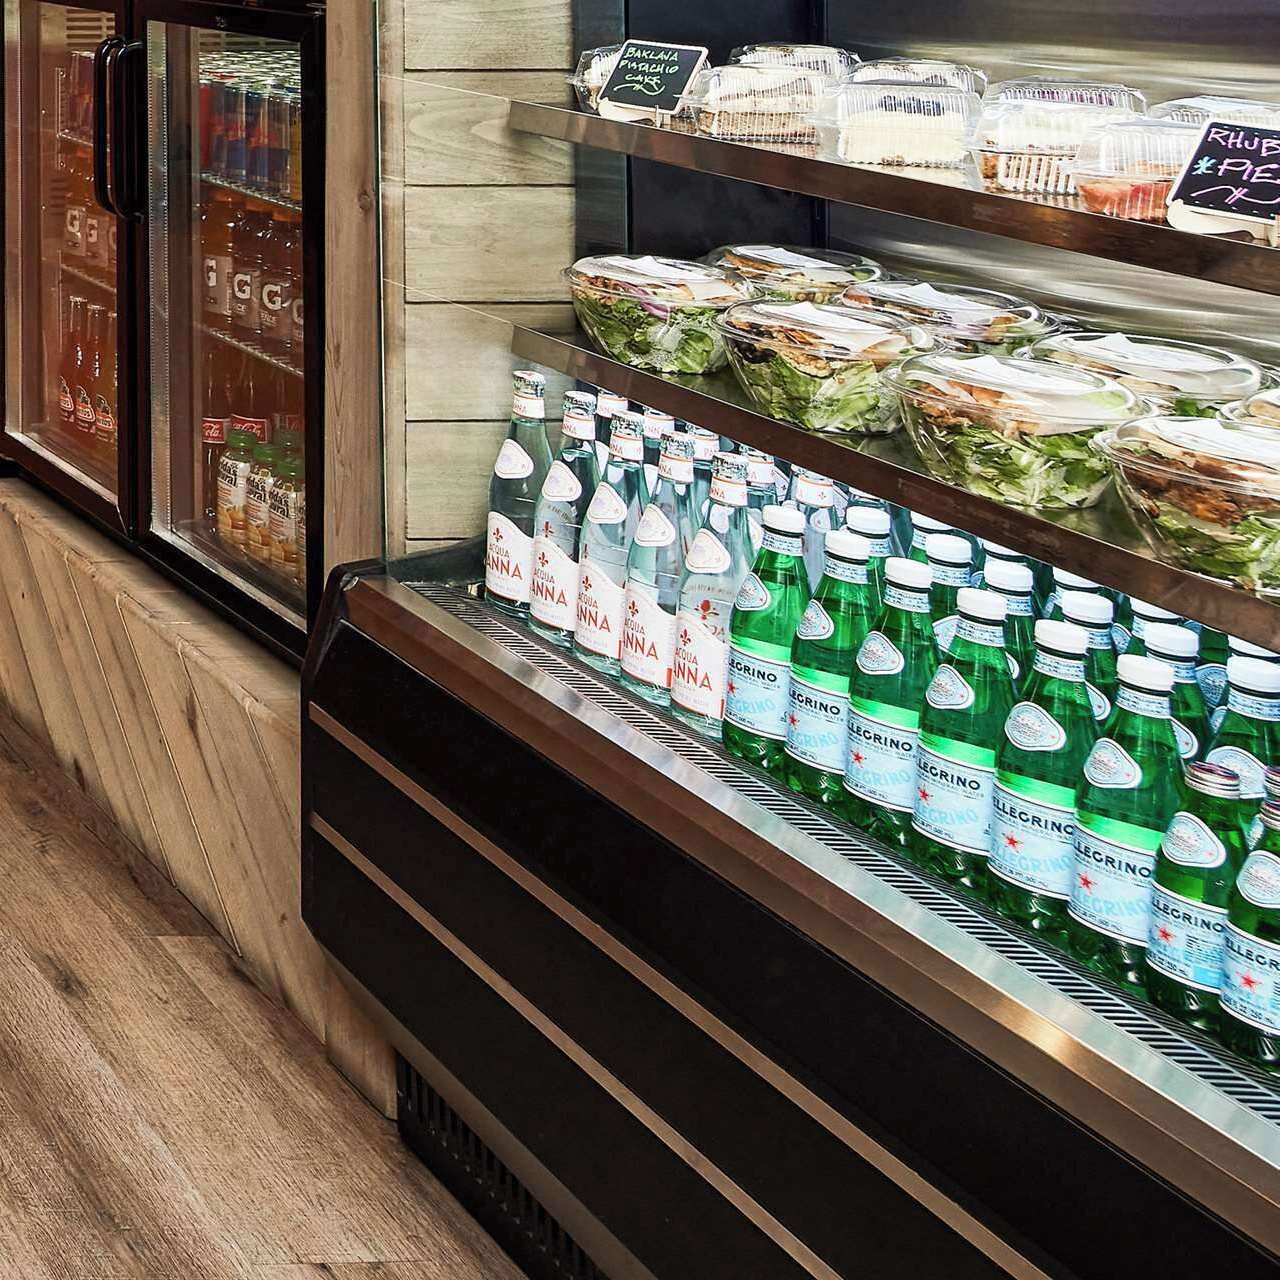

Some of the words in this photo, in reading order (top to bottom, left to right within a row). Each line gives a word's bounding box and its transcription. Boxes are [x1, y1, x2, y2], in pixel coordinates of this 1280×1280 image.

[618, 60, 680, 74] PISTACHIO
[66, 208, 80, 234] G
[86, 218, 99, 243] G
[203, 257, 217, 287] G
[233, 273, 251, 300] G
[262, 283, 283, 311] G
[488, 543, 510, 558] ACQUA
[533, 567, 555, 584] ACQUA
[577, 591, 599, 609] ACQUA
[624, 617, 645, 635] ACQUA
[674, 646, 698, 665] ACQUA
